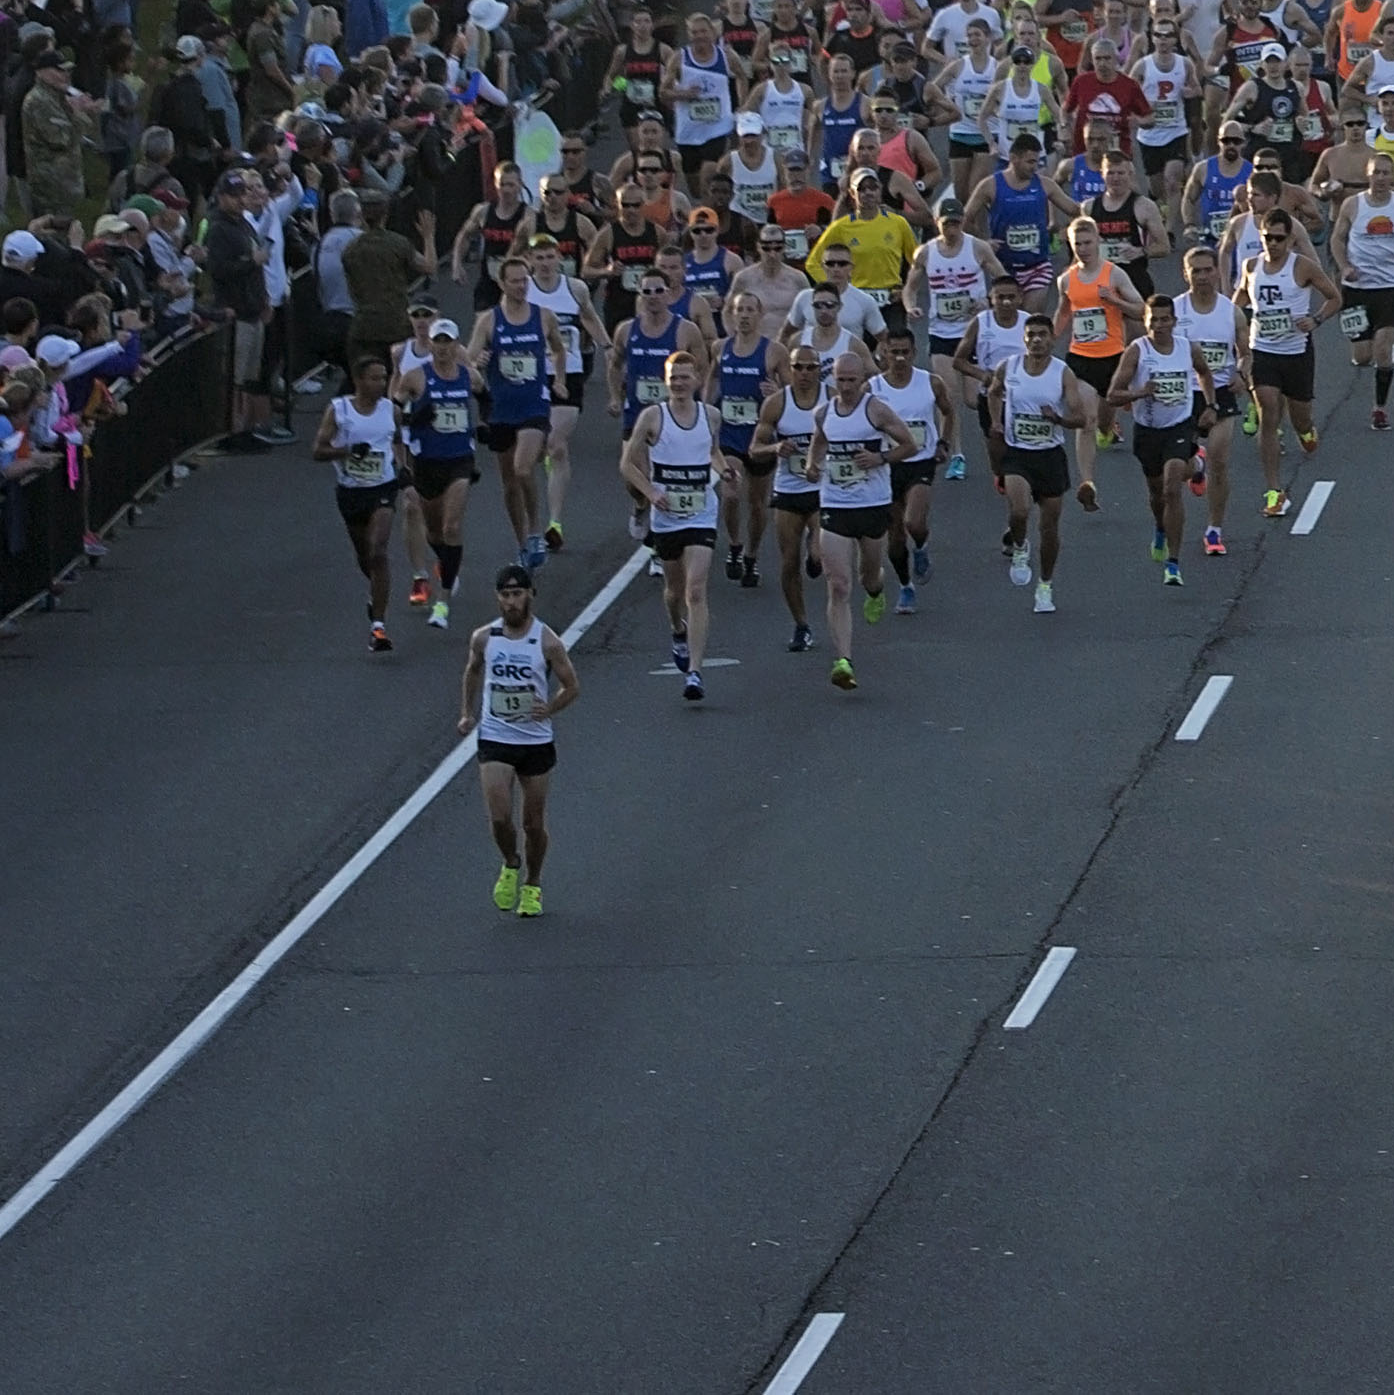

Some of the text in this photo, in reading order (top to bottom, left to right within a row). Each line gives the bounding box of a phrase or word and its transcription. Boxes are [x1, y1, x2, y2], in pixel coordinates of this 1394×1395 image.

[1157, 80, 1174, 101] P
[943, 301, 962, 313] 145
[1082, 319, 1095, 332] 19
[511, 359, 524, 373] 70
[646, 385, 660, 398] 73
[731, 405, 744, 417] 74
[444, 412, 457, 425] 71
[661, 468, 709, 480] ROYAL NAVY
[839, 465, 854, 477] 82
[679, 496, 694, 508] 84
[491, 664, 533, 681] GRC
[505, 696, 520, 711] 13
